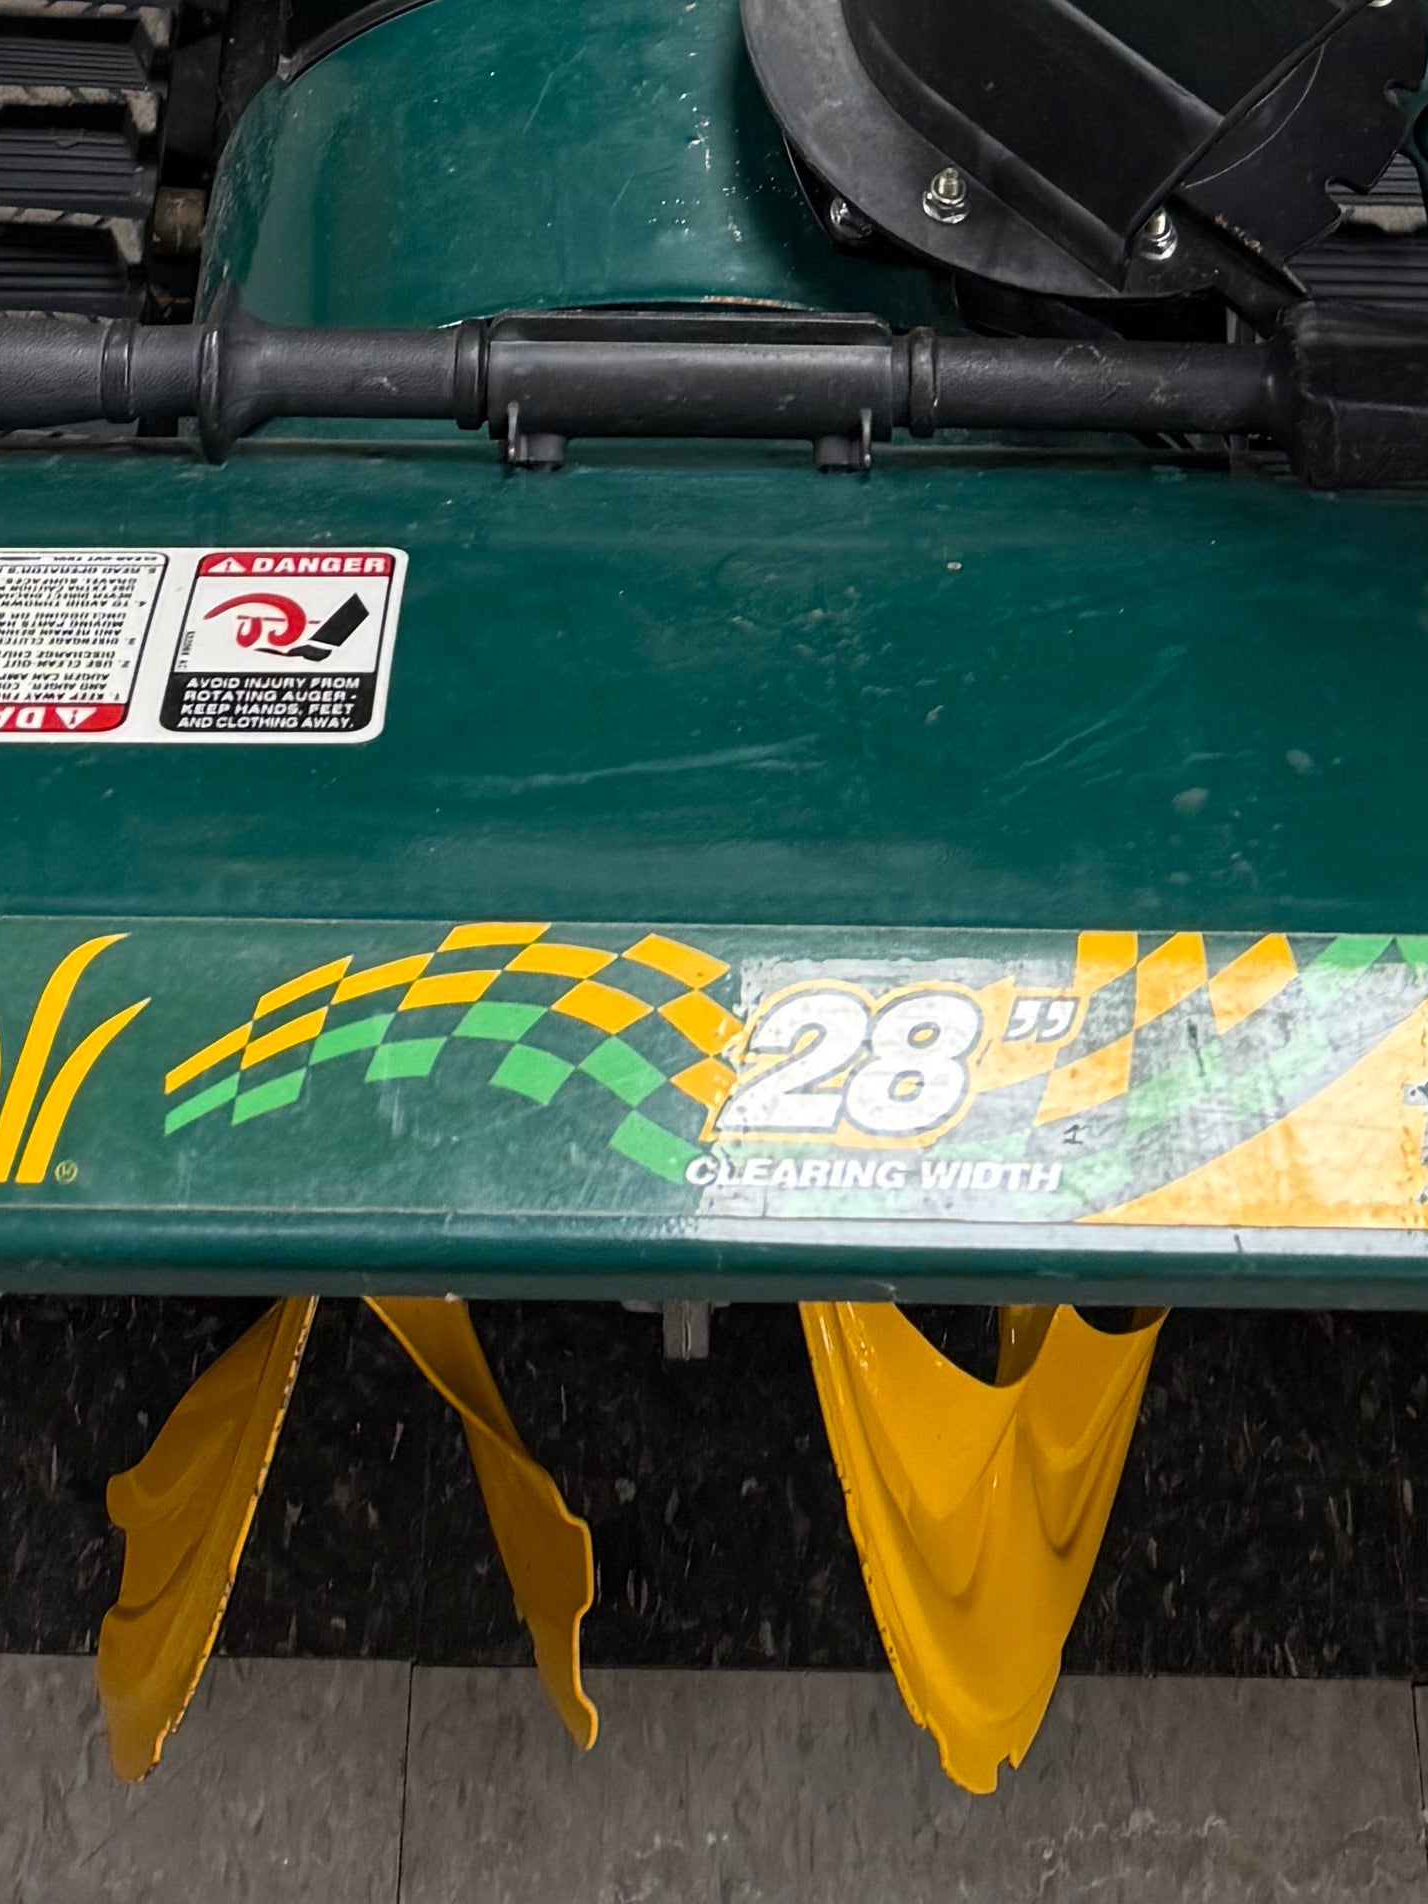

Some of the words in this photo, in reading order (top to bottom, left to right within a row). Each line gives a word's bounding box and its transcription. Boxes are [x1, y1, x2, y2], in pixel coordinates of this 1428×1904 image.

[251, 557, 386, 573] DANGER
[186, 678, 240, 689] AVOID
[244, 678, 307, 689] INJURY
[309, 678, 360, 689] FROM
[183, 690, 275, 702] ROTATING
[281, 690, 345, 702] AUGER
[180, 704, 231, 715] KEEP
[234, 704, 302, 715] HANDS,
[308, 704, 354, 714] FEET
[177, 717, 212, 728] AND
[215, 717, 298, 728] CLOTHING
[301, 717, 354, 728] AWAY.
[685, 1156, 911, 1191] CLEARING
[920, 1160, 1063, 1194] WIDTH
